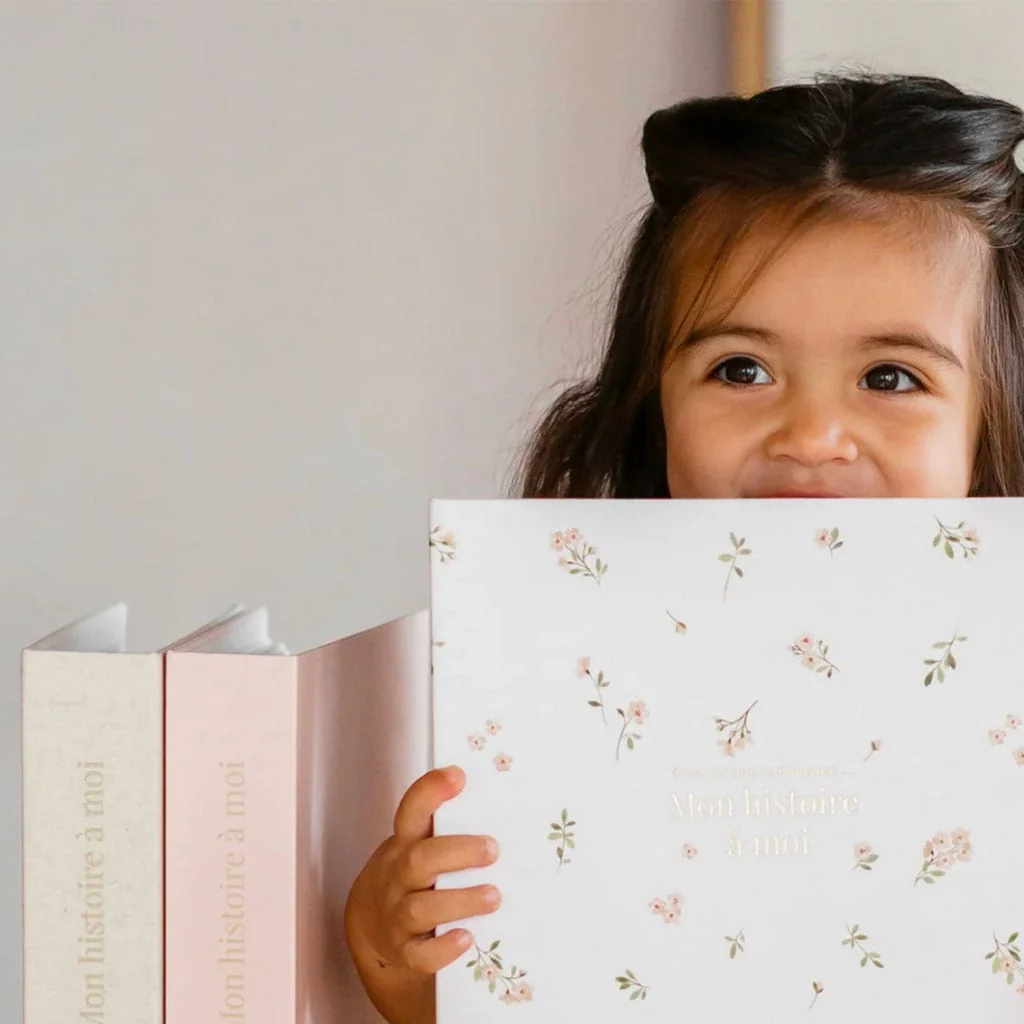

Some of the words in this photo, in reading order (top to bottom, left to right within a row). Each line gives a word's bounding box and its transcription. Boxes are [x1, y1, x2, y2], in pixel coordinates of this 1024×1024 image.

[77, 761, 104, 817] moi
[218, 762, 245, 817] moi
[670, 792, 735, 818] Mon
[744, 788, 860, 816] histoire
[74, 827, 104, 843] à
[217, 827, 245, 843] à
[753, 828, 810, 856] moi
[77, 851, 104, 964] histoire
[217, 852, 245, 964] histoire
